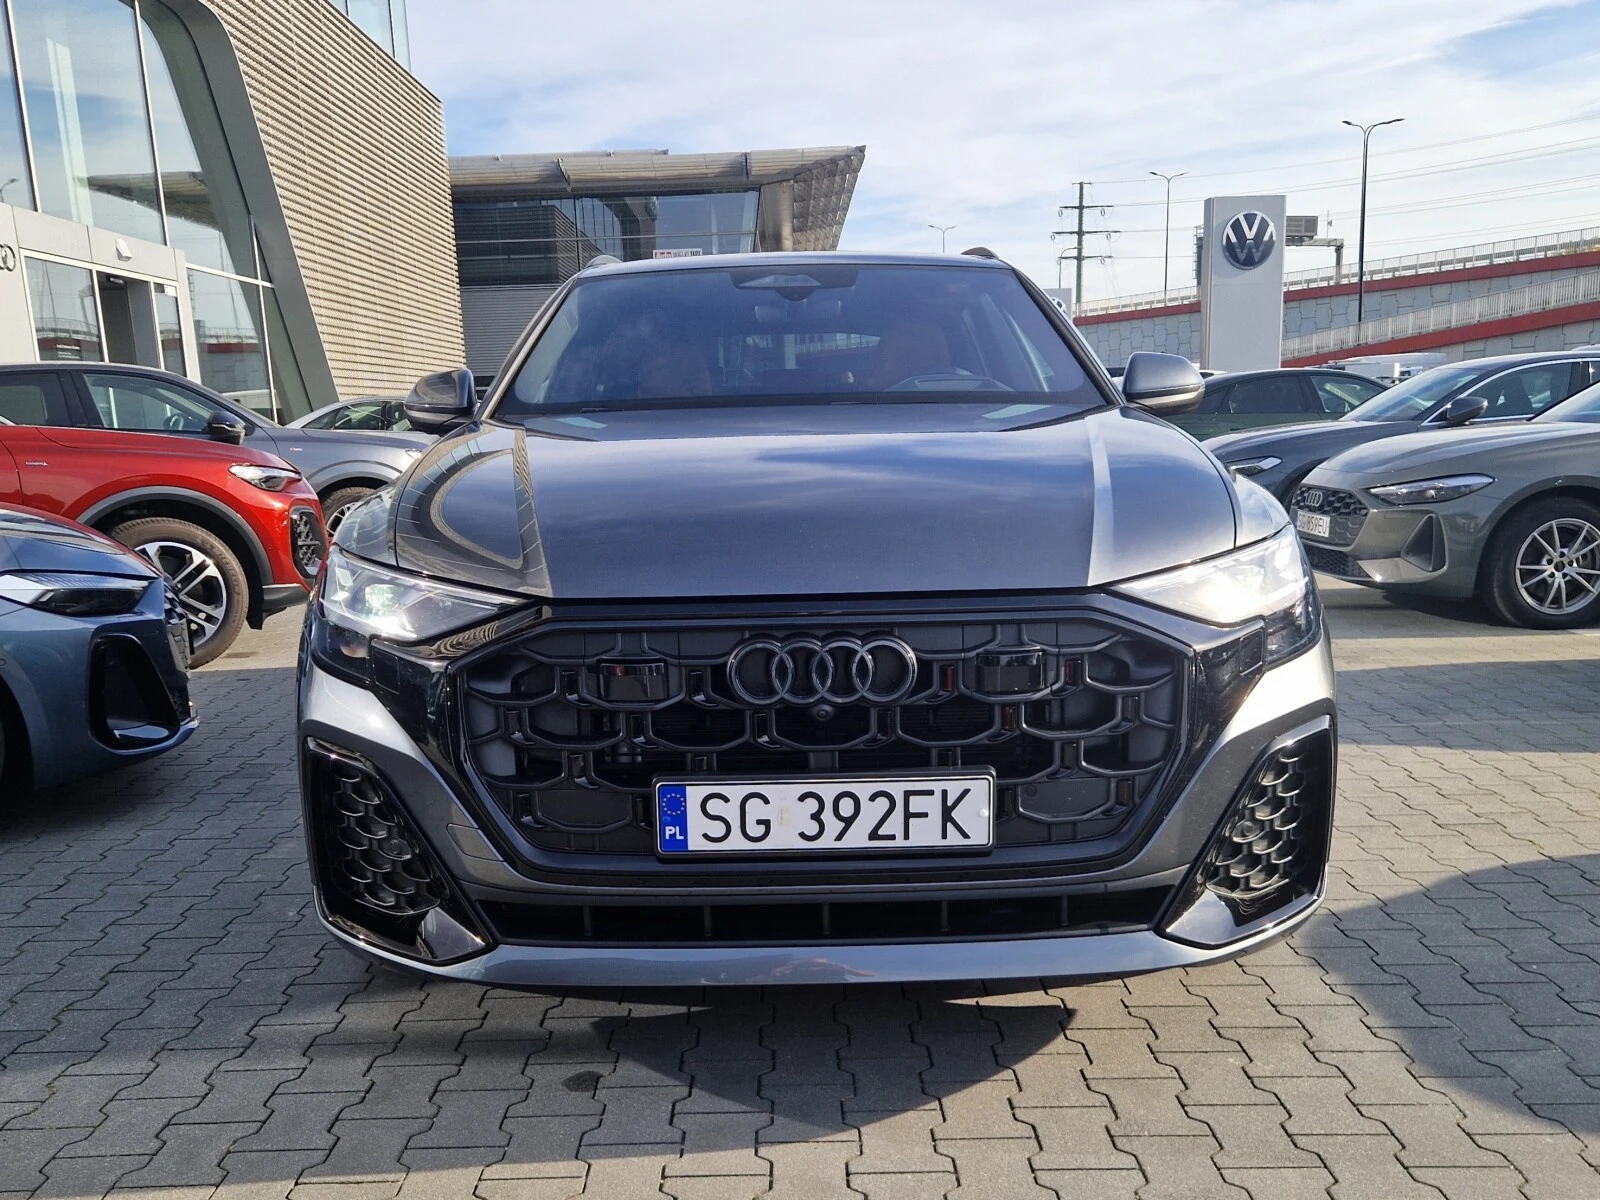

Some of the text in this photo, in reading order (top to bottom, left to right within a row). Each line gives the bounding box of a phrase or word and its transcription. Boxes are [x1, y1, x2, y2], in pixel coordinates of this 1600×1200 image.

[1224, 211, 1275, 267] VW
[665, 826, 685, 840] PL
[700, 789, 972, 843] SG 392FK
